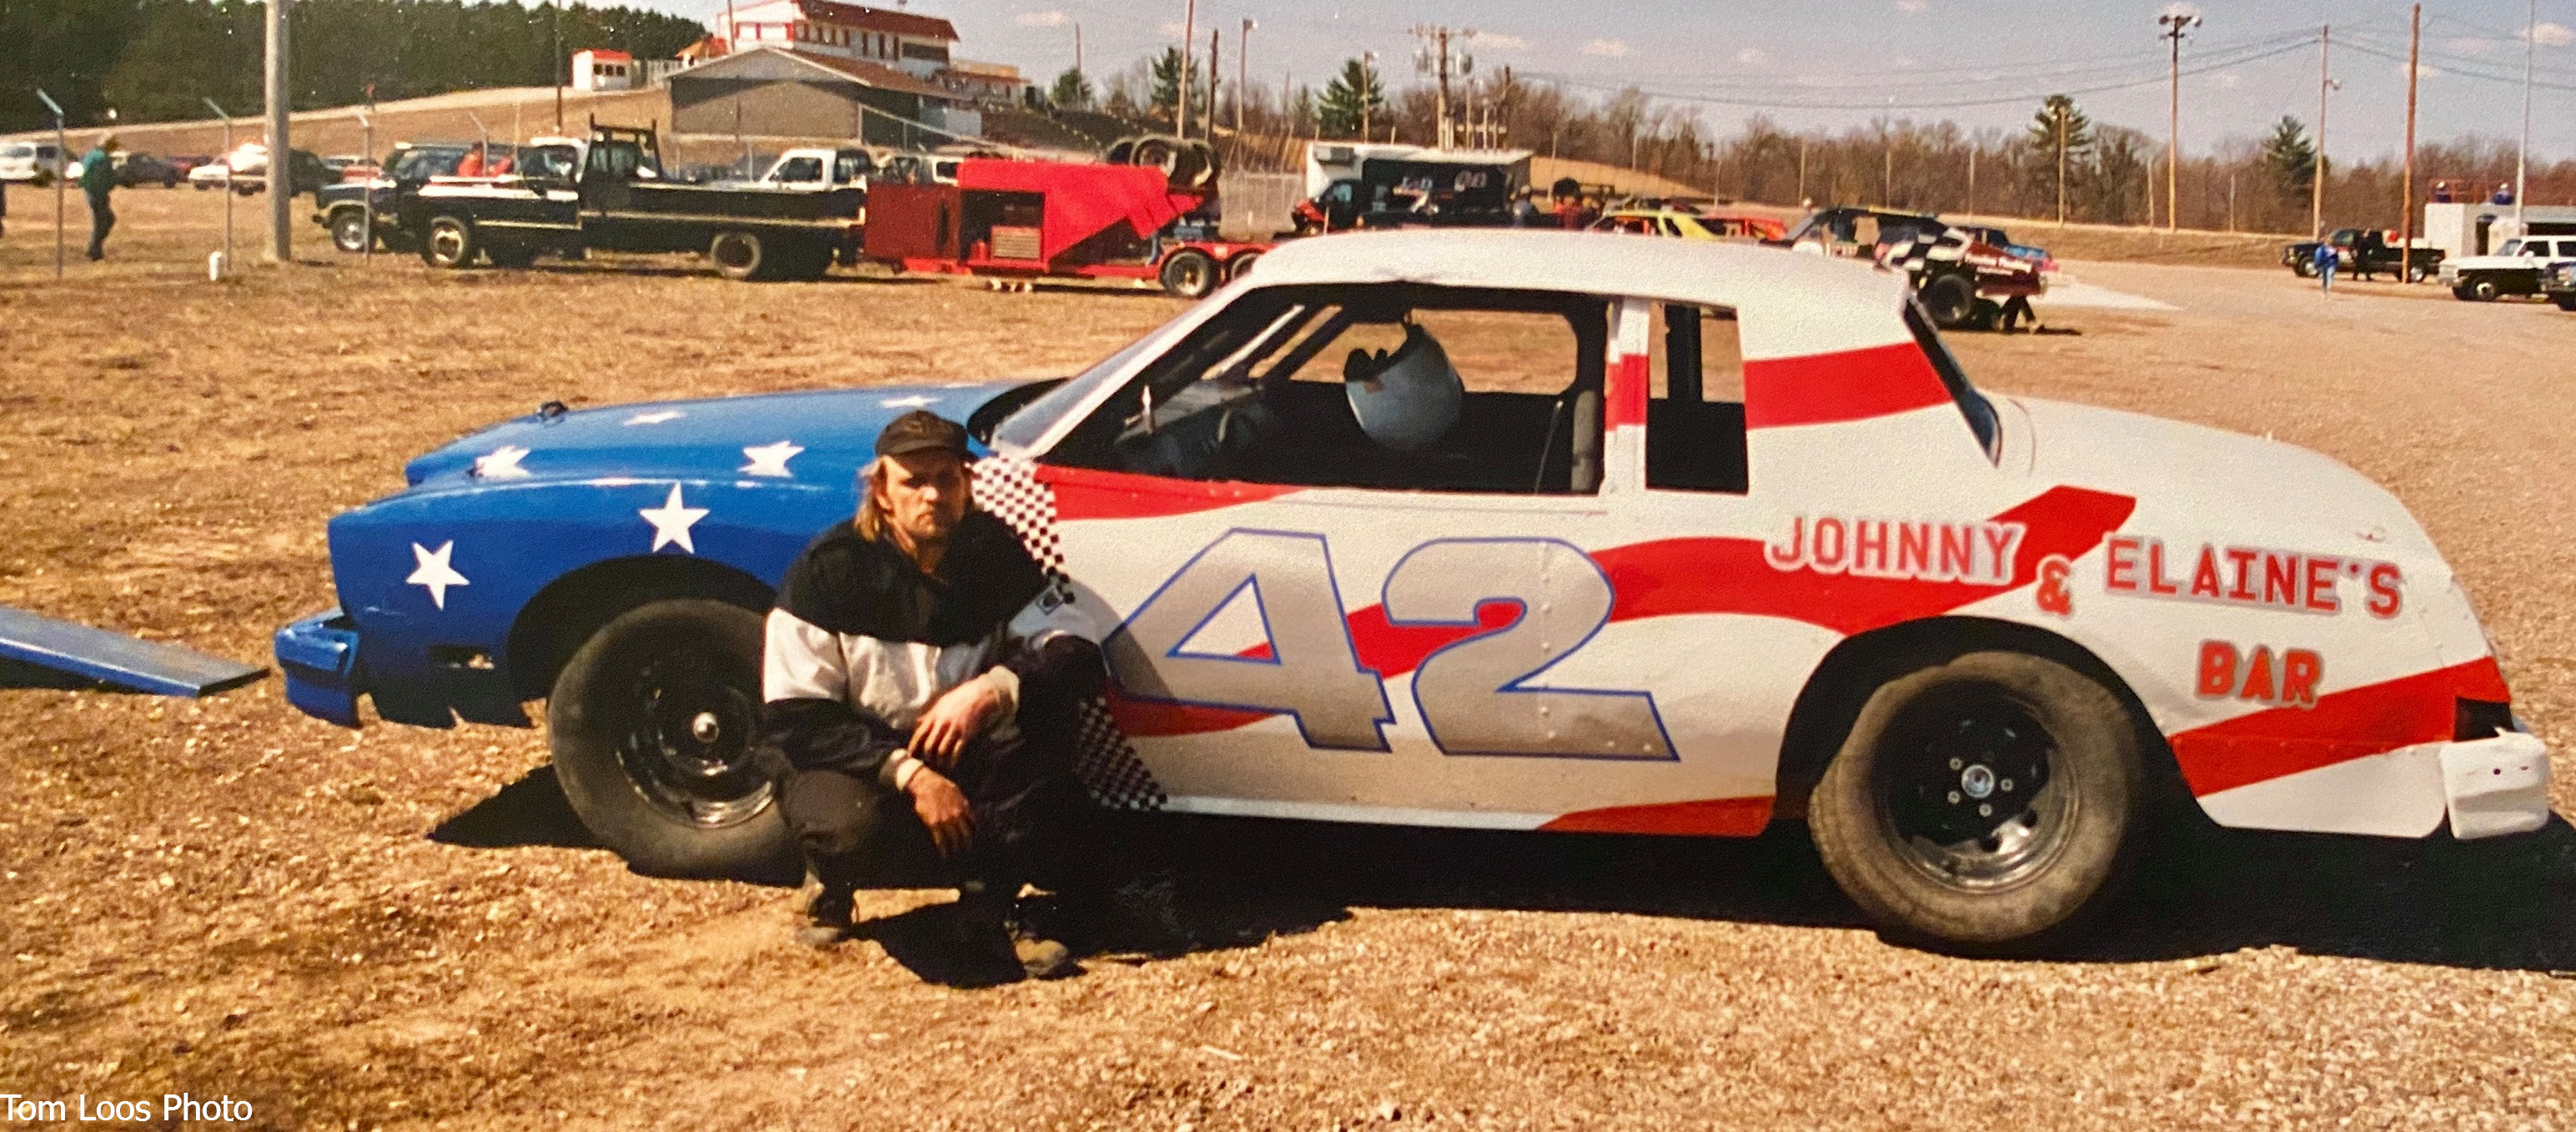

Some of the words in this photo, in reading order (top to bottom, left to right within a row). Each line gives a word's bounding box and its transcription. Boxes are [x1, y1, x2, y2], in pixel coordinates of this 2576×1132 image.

[1770, 515, 2022, 581] JOHNNY
[2036, 557, 2073, 617] &
[2106, 537, 2403, 619] ELAINE'S
[1101, 527, 1681, 762] 42
[2197, 639, 2322, 706] BAR
